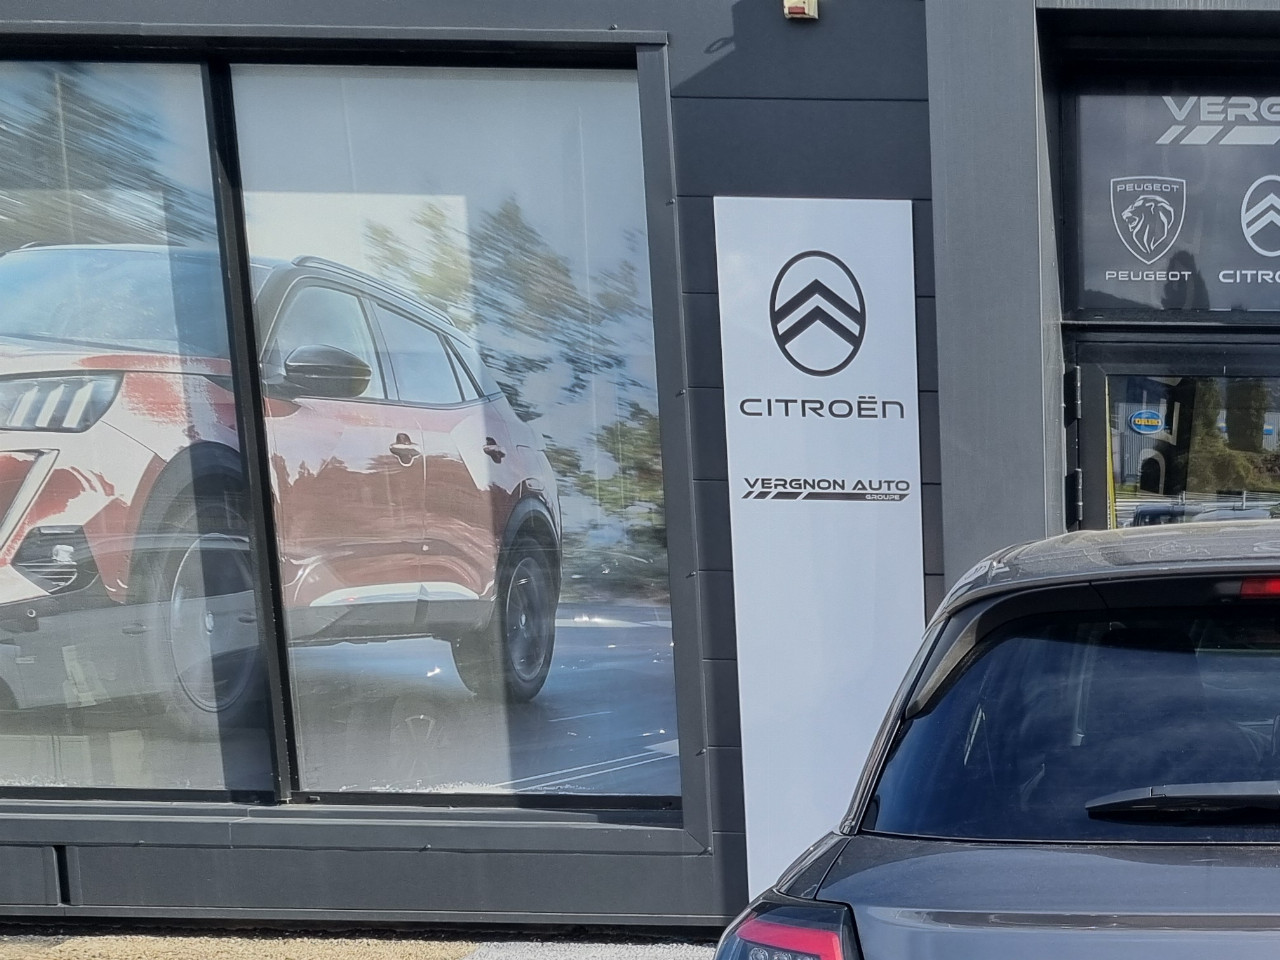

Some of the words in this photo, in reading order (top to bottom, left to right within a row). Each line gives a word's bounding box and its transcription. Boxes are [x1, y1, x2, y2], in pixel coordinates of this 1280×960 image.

[1116, 183, 1180, 193] PEUGEOT
[1105, 270, 1192, 282] PEUGEOT
[739, 395, 905, 419] CITROËN
[744, 477, 846, 491] VERGNON
[852, 478, 910, 492] AUTO
[865, 493, 900, 501] GROUPE
